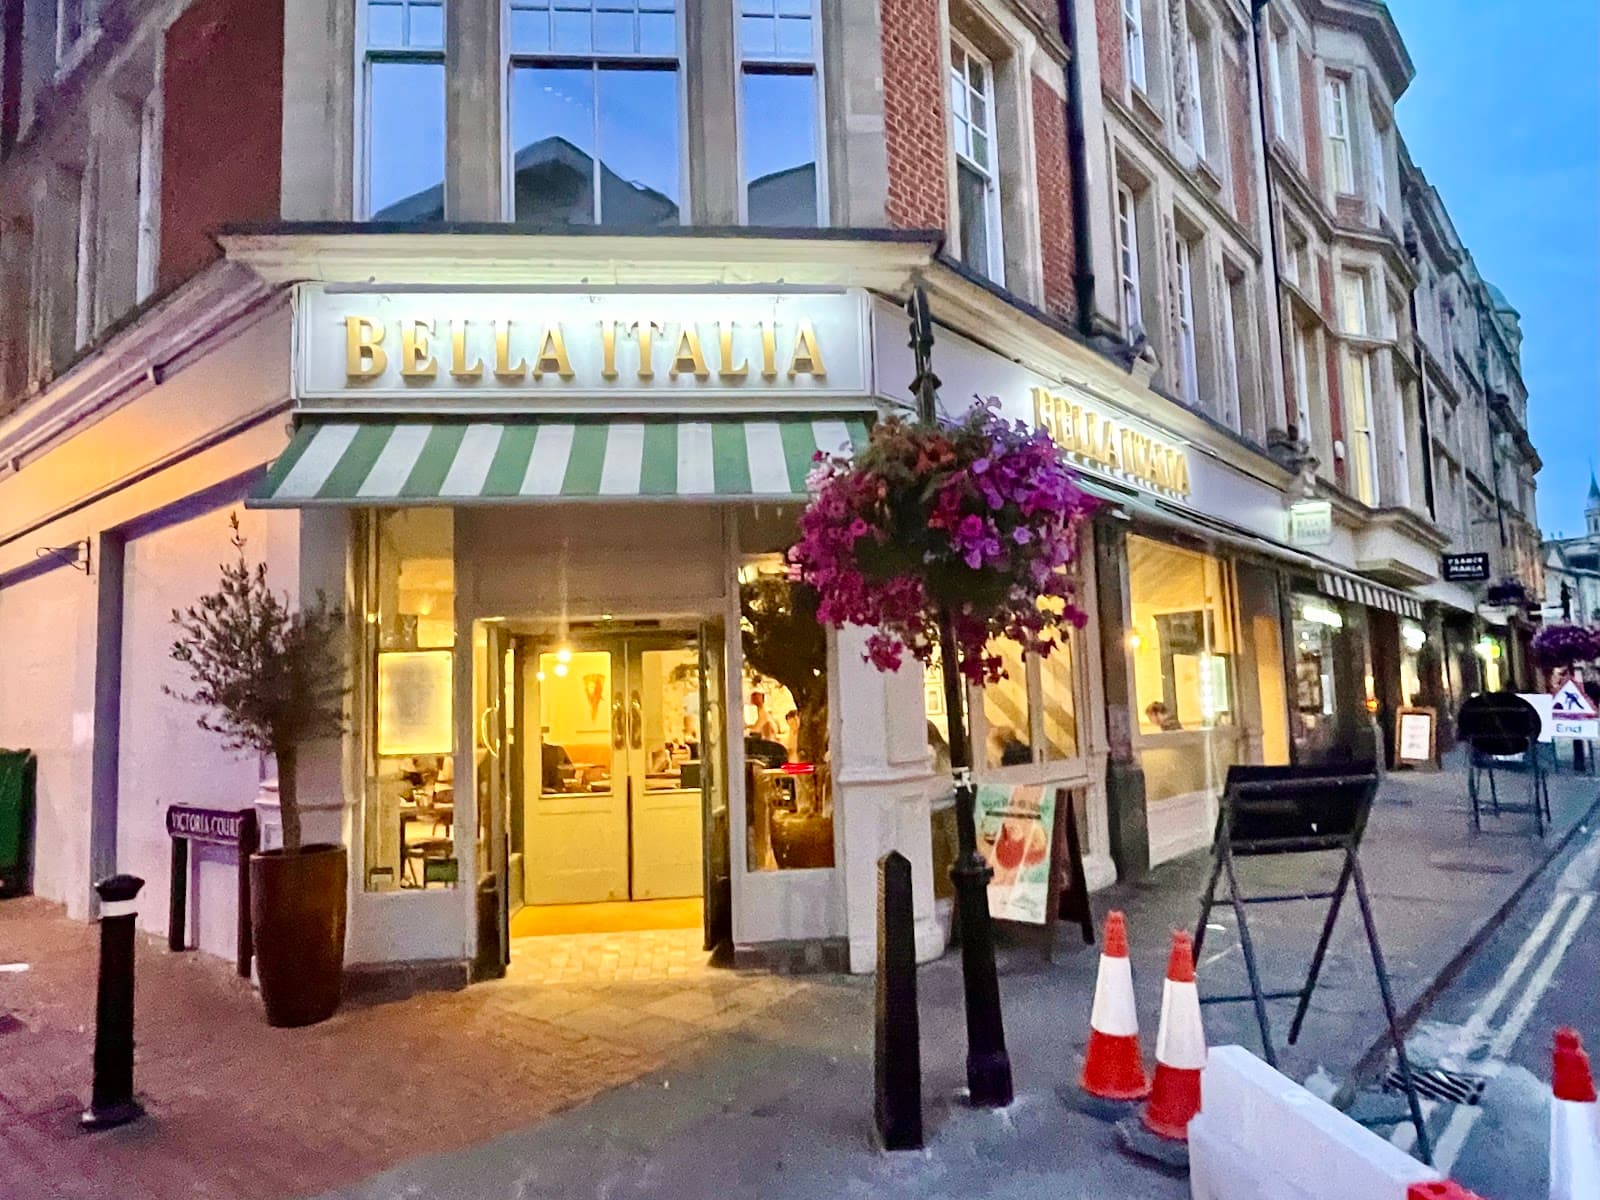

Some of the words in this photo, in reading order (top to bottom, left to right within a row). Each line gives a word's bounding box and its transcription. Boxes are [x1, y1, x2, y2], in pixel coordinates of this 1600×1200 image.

[344, 316, 576, 377] BELLA
[601, 318, 827, 377] ITALIA
[1556, 723, 1582, 733] End
[171, 811, 210, 833] VICTORIA
